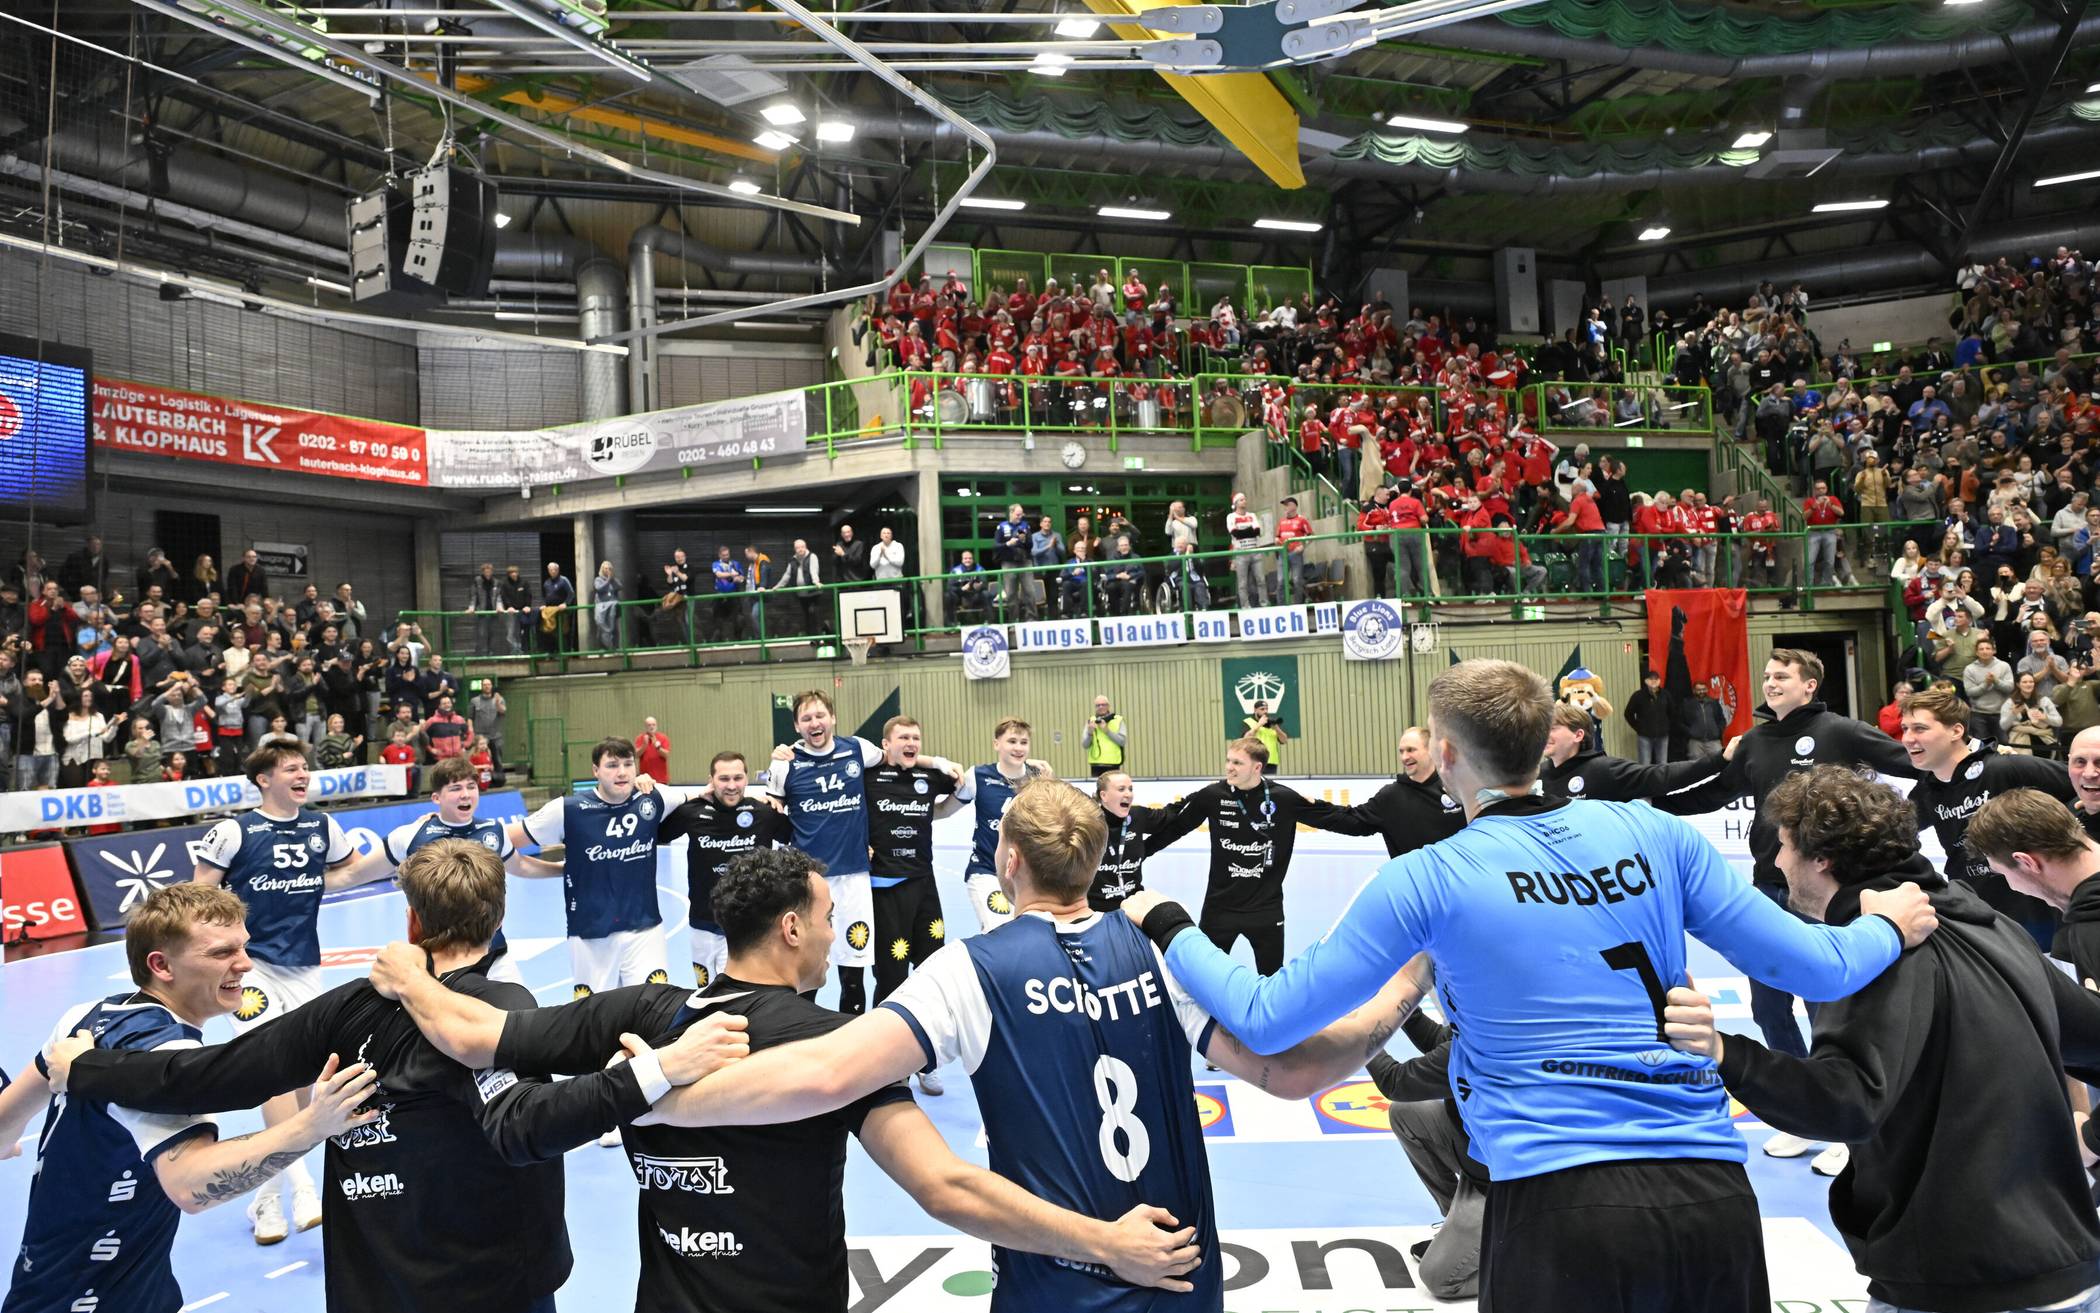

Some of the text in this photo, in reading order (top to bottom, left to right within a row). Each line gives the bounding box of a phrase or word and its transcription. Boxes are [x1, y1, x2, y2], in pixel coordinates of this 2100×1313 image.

[160, 394, 212, 413] Logistik
[115, 426, 228, 457] KLOPHAUS
[298, 433, 337, 451] 0202
[349, 440, 367, 455] 87
[370, 443, 388, 458] 00
[411, 448, 421, 462] 0
[614, 432, 652, 449] RÜBEL
[678, 448, 706, 463] 0202
[717, 444, 739, 458] 460
[742, 441, 758, 454] 48
[760, 437, 776, 451] 43
[300, 456, 421, 481] lauterbach-klophaus.de
[1349, 603, 1394, 623] Blue Lions
[1022, 607, 1338, 647] Jungs, glaubt an euch !!!
[185, 782, 243, 809] DKB
[319, 771, 367, 796] DKB
[815, 773, 846, 793] 14
[41, 794, 103, 822] DKB
[800, 793, 861, 813] Coroplast
[877, 799, 930, 814] Coroplast
[606, 813, 638, 838] 49
[698, 834, 757, 851] Coroplast
[273, 844, 310, 869] 53
[484, 1077, 513, 1099] HBL
[1093, 1054, 1150, 1183] 8
